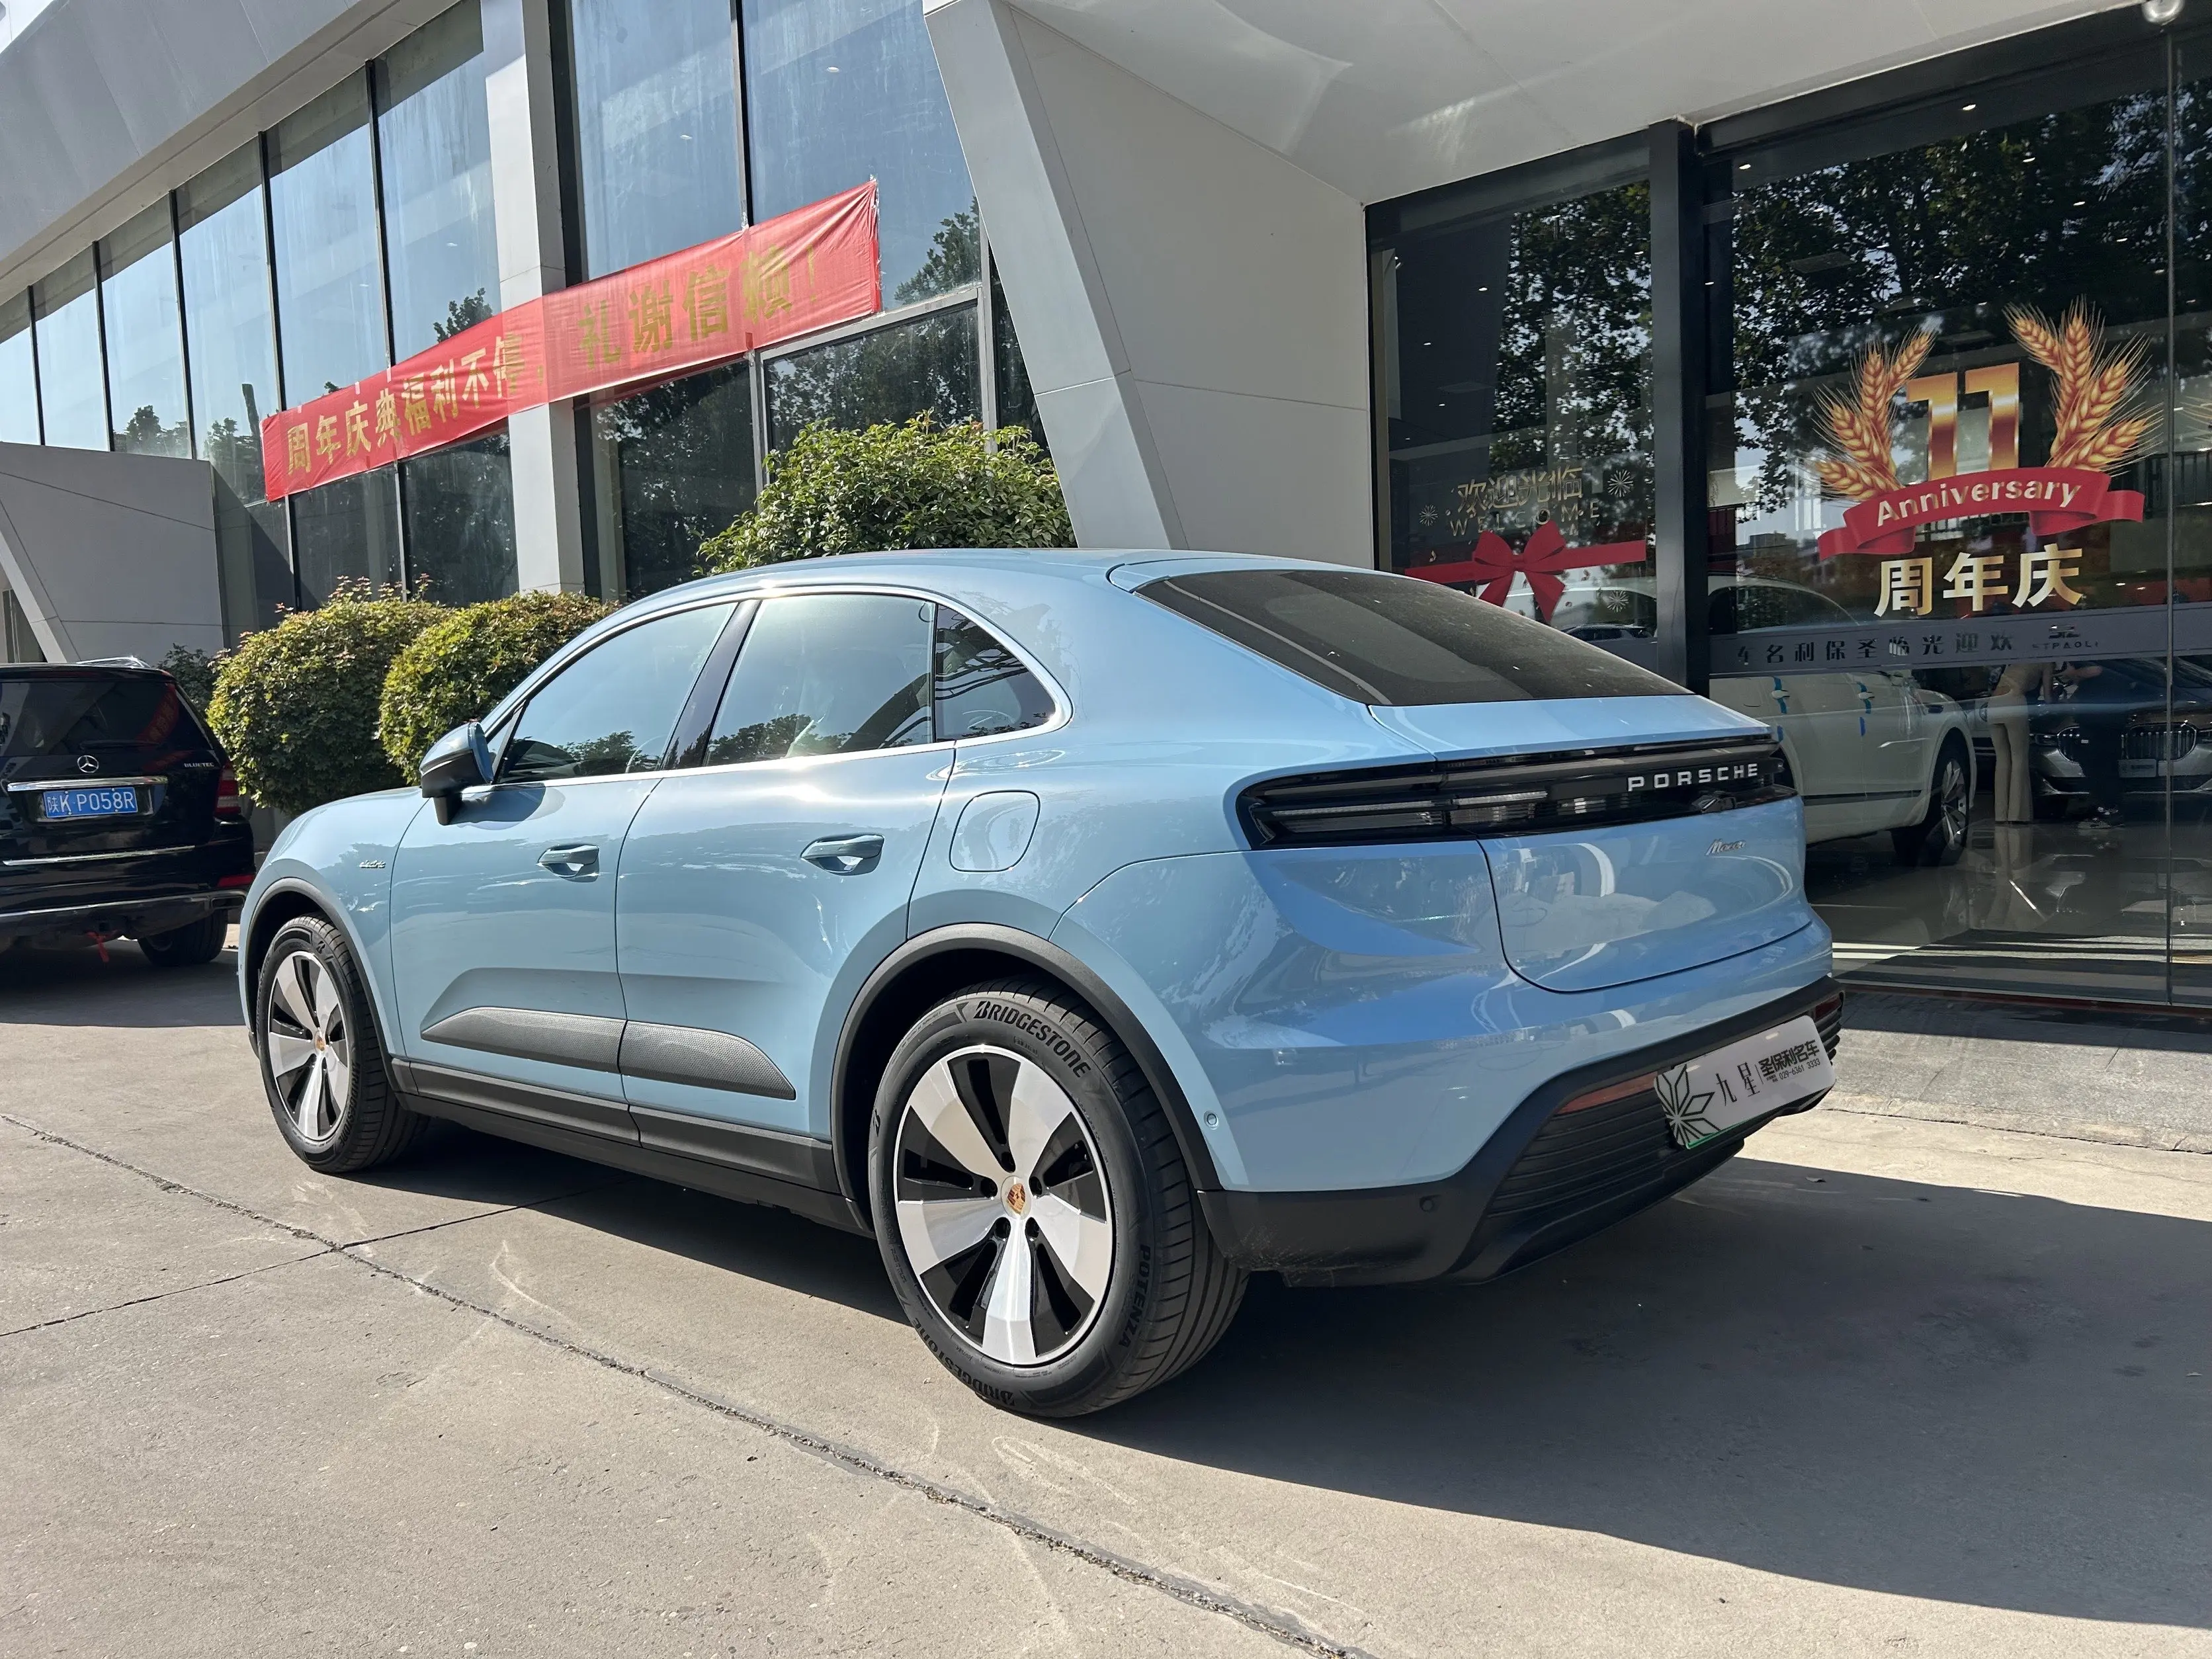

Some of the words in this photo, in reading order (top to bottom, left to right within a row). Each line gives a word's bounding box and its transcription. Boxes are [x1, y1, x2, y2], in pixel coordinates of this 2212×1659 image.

[1906, 362, 2020, 481] 11
[1457, 466, 1583, 514] 欢迎光临
[1877, 480, 2082, 527] Anniversary
[1449, 499, 1600, 536] WELCOME
[1873, 543, 2083, 617] 周年庆
[1627, 763, 1758, 792] PORSCHE
[973, 1000, 1091, 1078] BRIDGESTONE
[1758, 1039, 1820, 1078] 圣保利名车
[1716, 1061, 1761, 1107] 九星
[1779, 1064, 1805, 1080] 029-6361
[1807, 1058, 1821, 1070] 3333
[1117, 1243, 1151, 1348] POTENZA
[912, 1317, 1016, 1407] BRIDGESTONE
